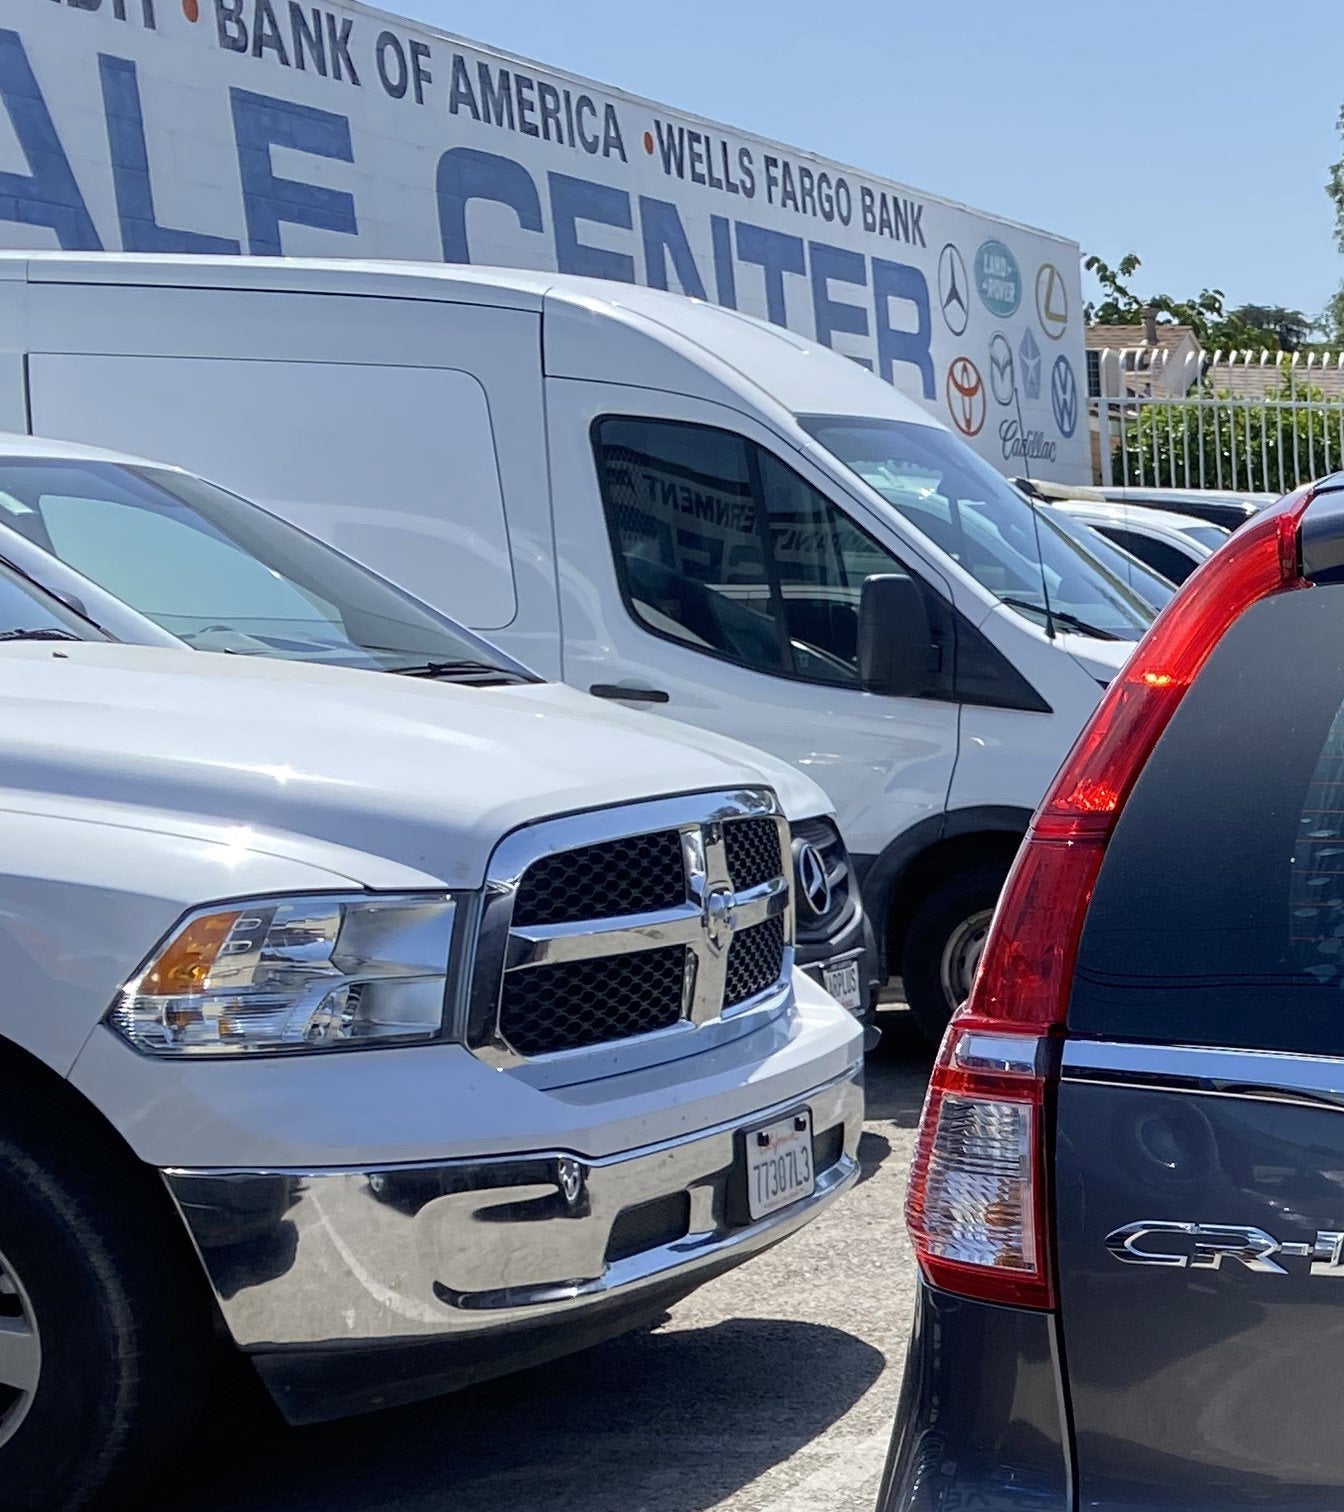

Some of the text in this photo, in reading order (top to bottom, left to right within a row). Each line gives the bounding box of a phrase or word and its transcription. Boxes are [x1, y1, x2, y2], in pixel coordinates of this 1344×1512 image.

[218, 0, 926, 249] BANK OF AMERICA WELLS FARGO BANK
[436, 146, 937, 402] CENTER
[999, 420, 1057, 463] Cadillac
